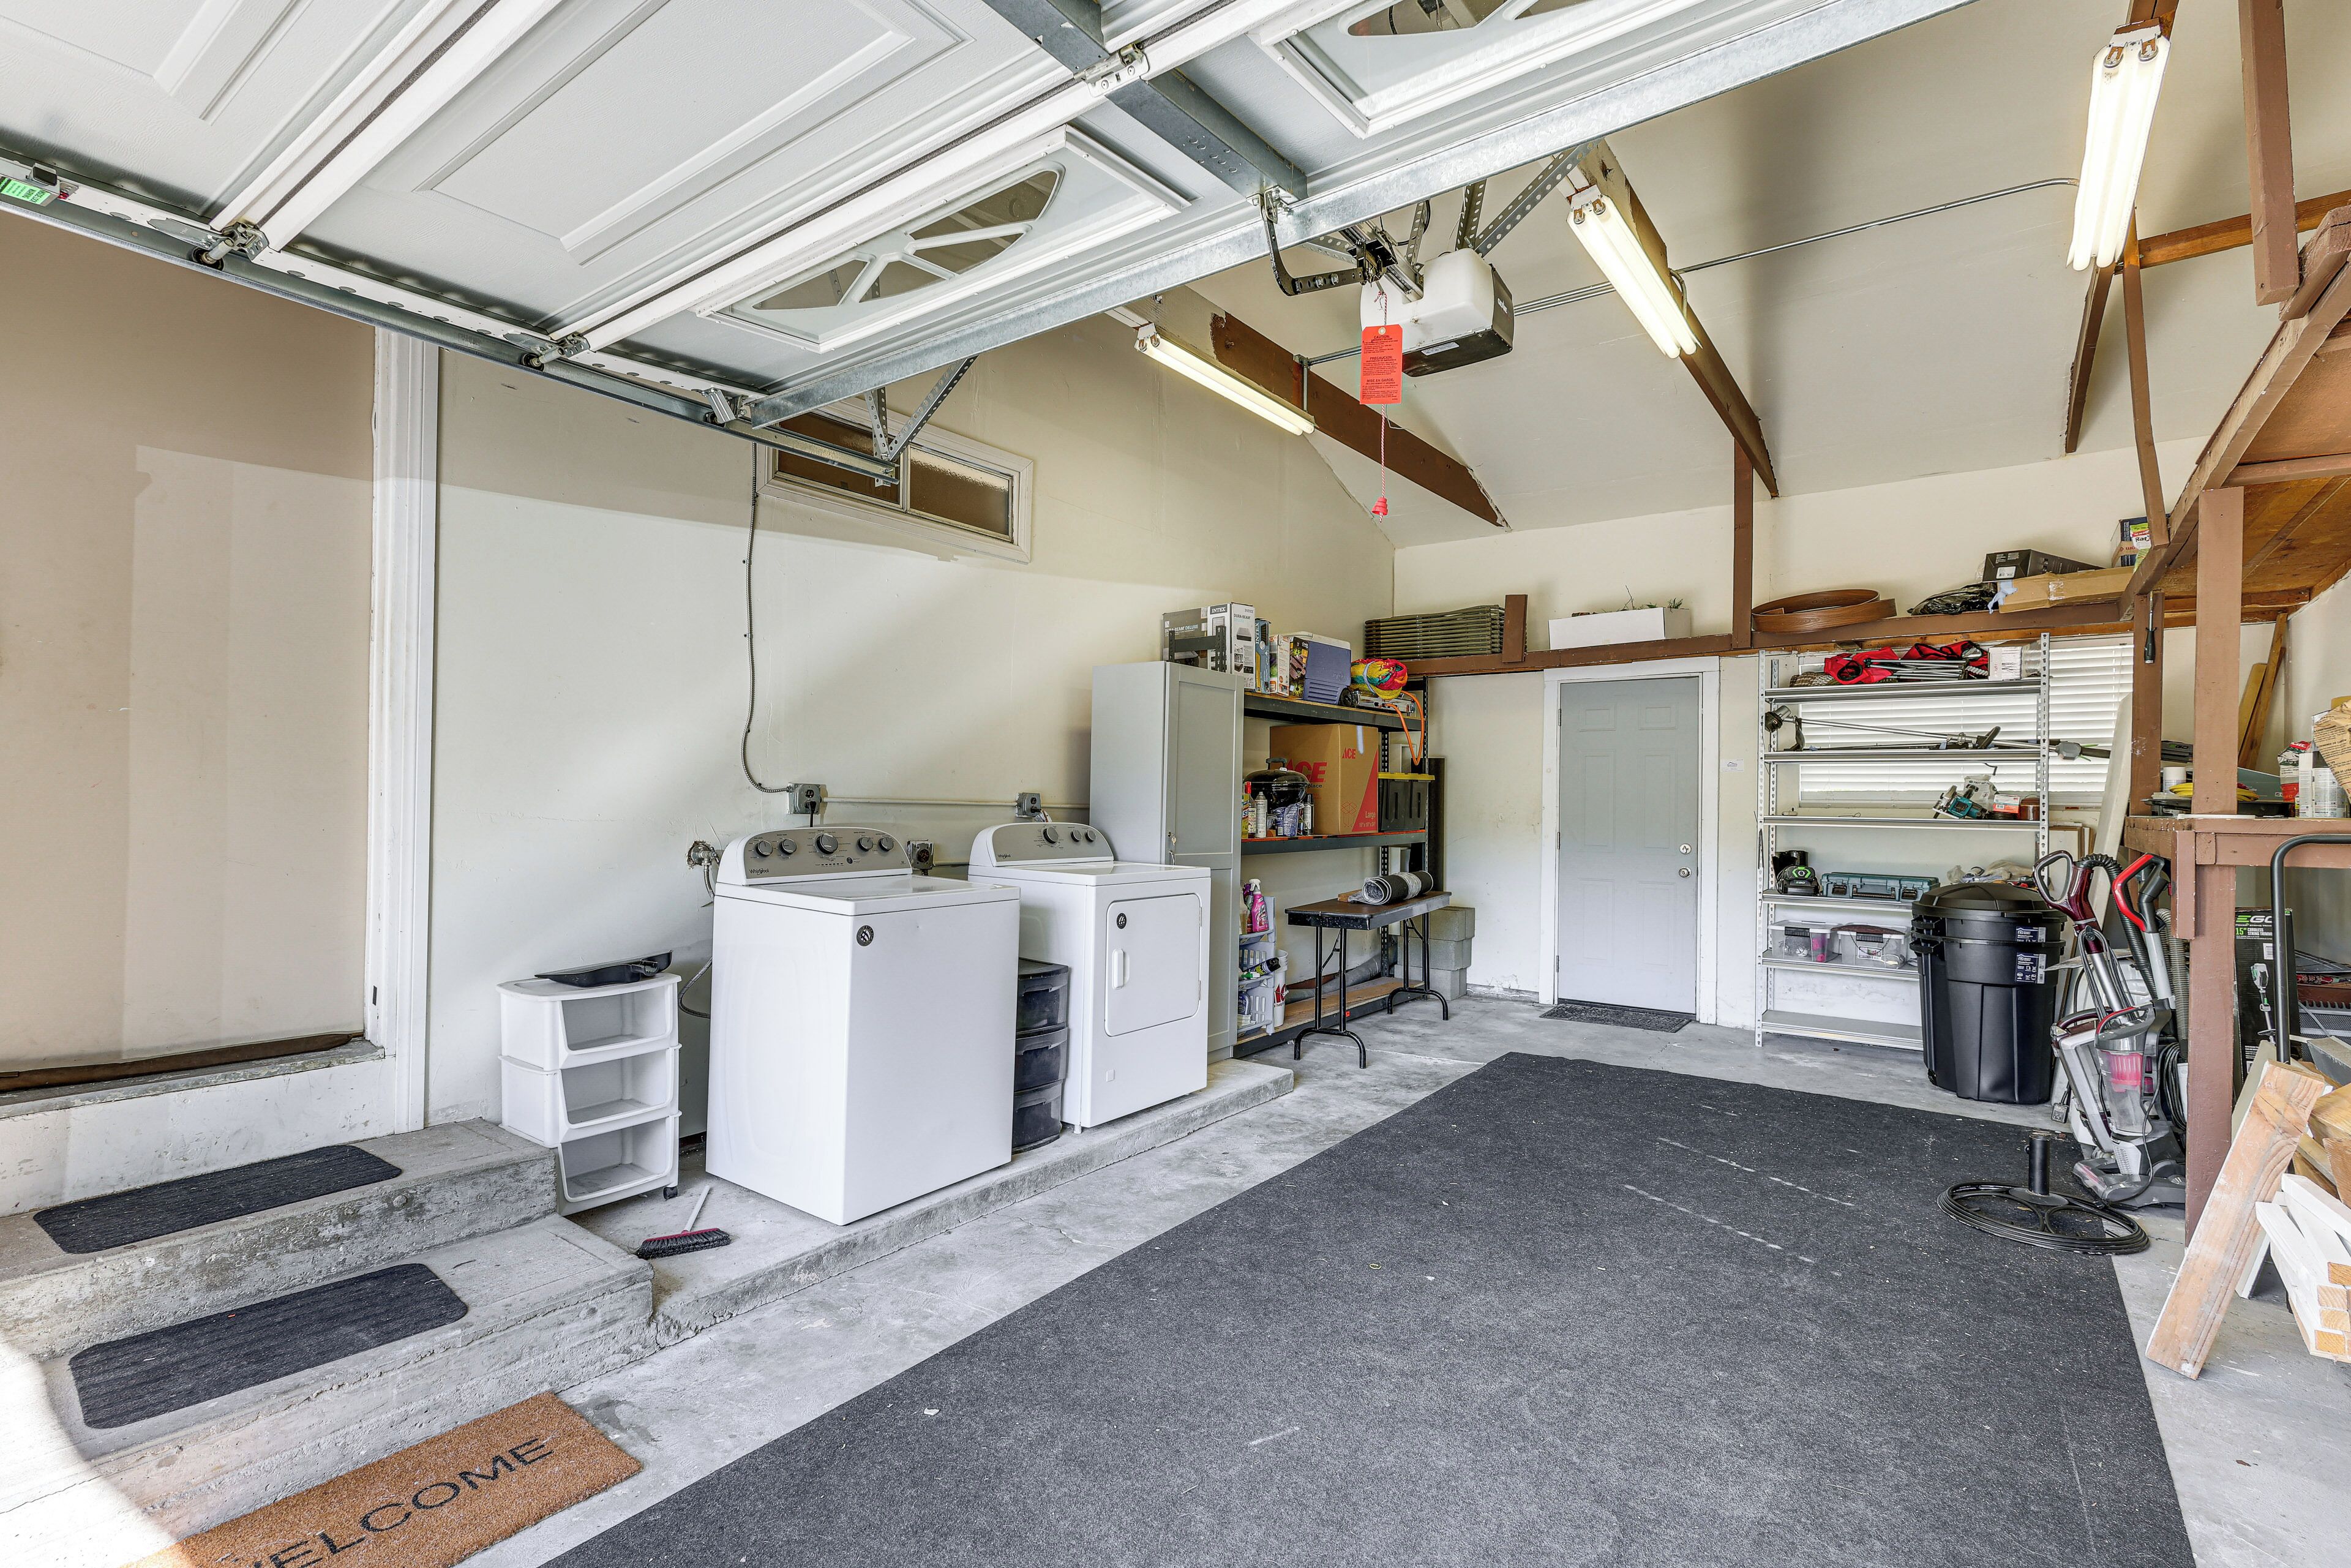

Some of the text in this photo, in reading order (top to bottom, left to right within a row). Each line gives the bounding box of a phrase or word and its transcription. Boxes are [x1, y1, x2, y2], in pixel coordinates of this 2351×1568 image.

[1342, 747, 1356, 759] ACE
[1365, 811, 1376, 819] Large
[1255, 965, 1264, 975] Raid
[252, 1438, 555, 1568] ELCOME
